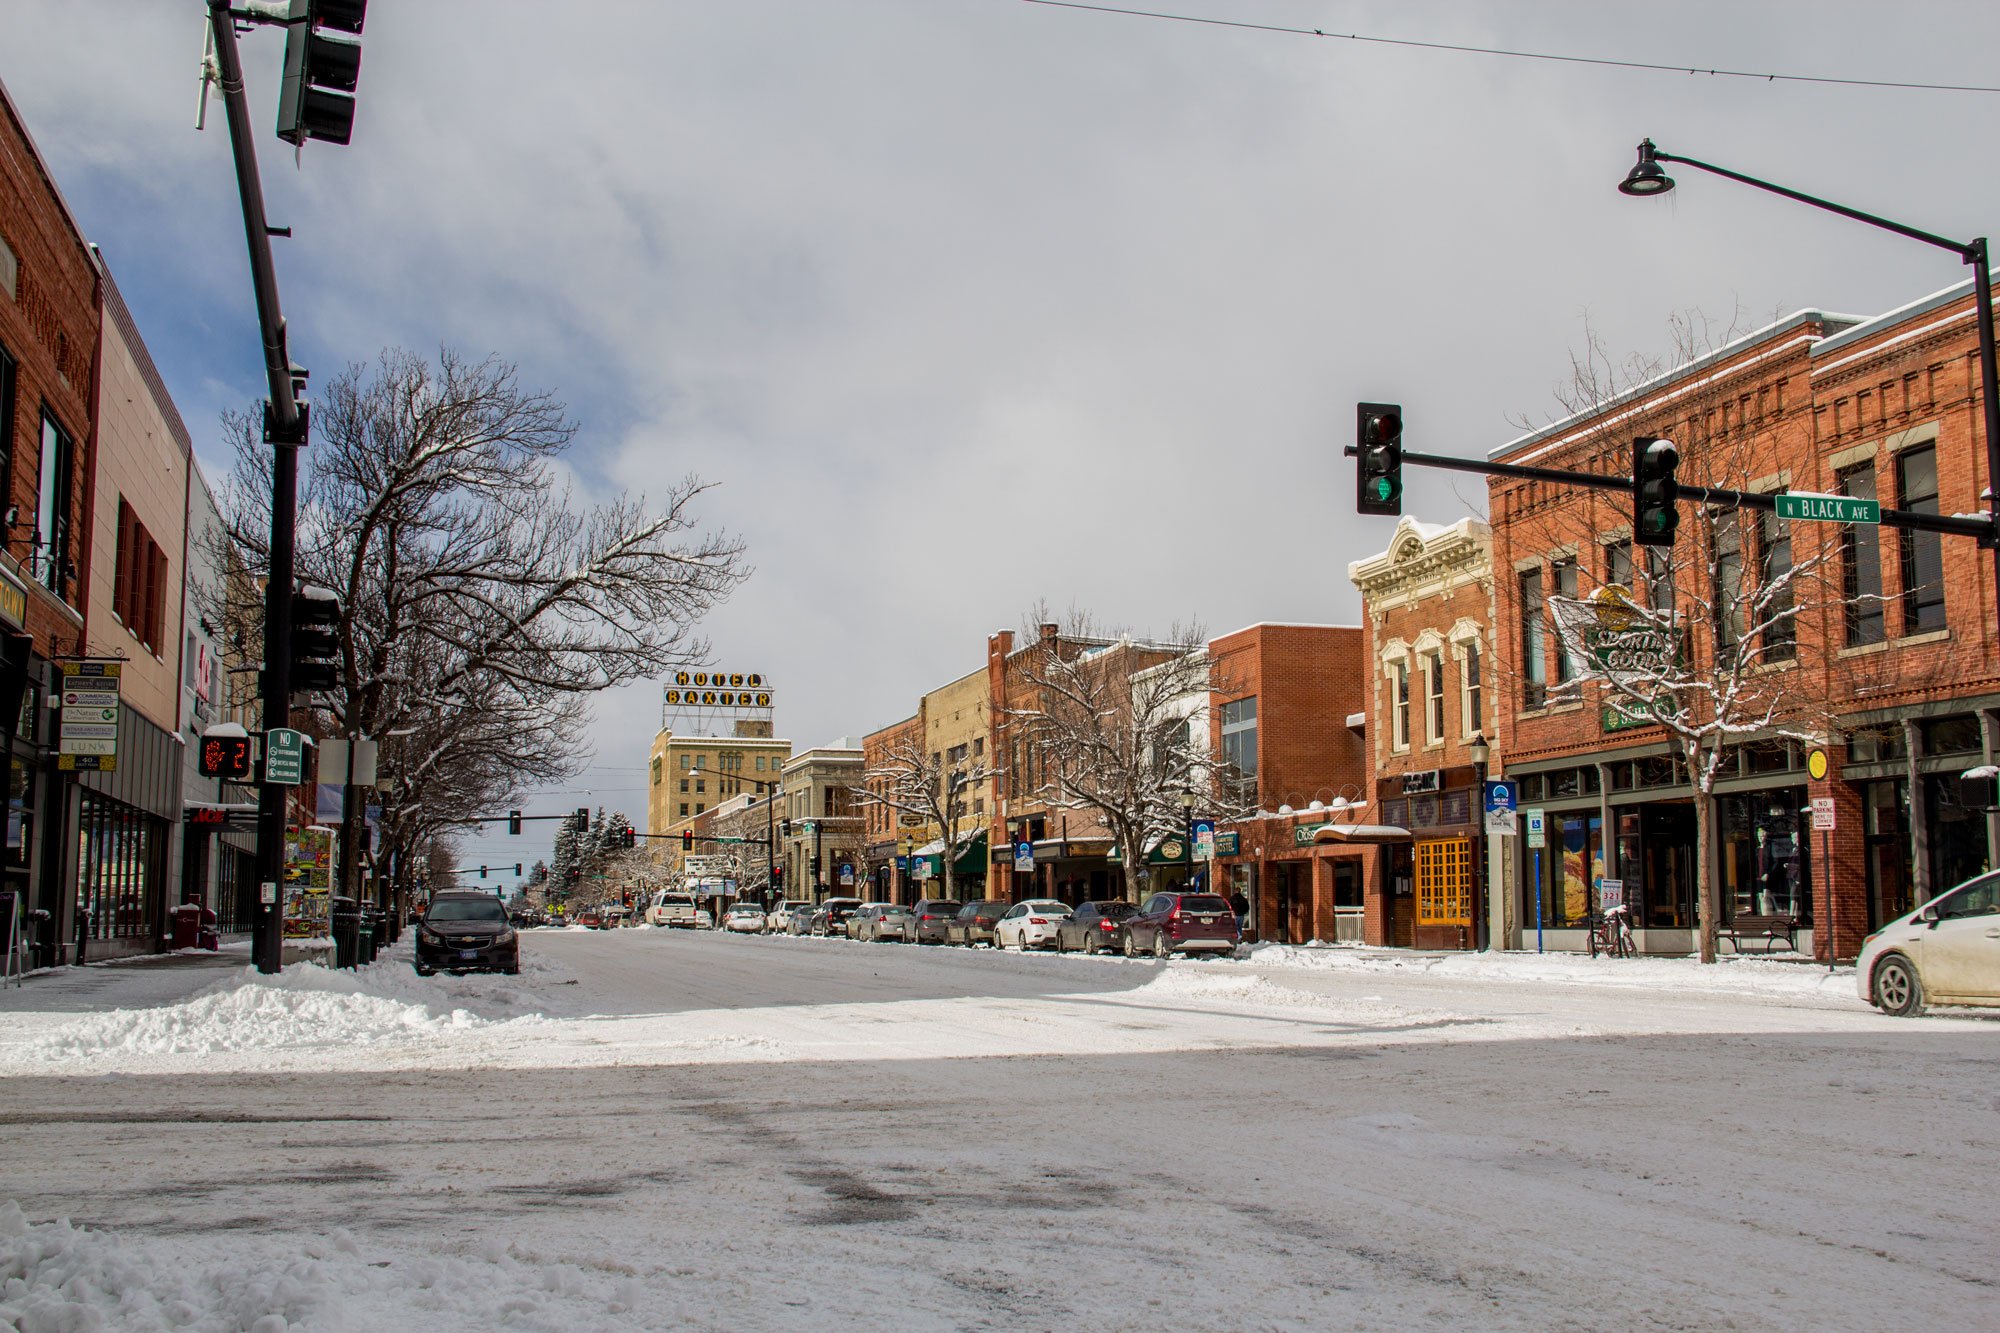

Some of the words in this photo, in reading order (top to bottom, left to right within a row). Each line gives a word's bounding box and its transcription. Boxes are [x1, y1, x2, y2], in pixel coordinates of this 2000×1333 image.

[1787, 502, 1793, 516] N
[1801, 499, 1844, 519] BLACK
[1852, 506, 1869, 520] AVE
[678, 671, 759, 688] HOTEL
[668, 690, 768, 706] BAXTER
[76, 708, 101, 717] Nature
[280, 732, 291, 745] NO
